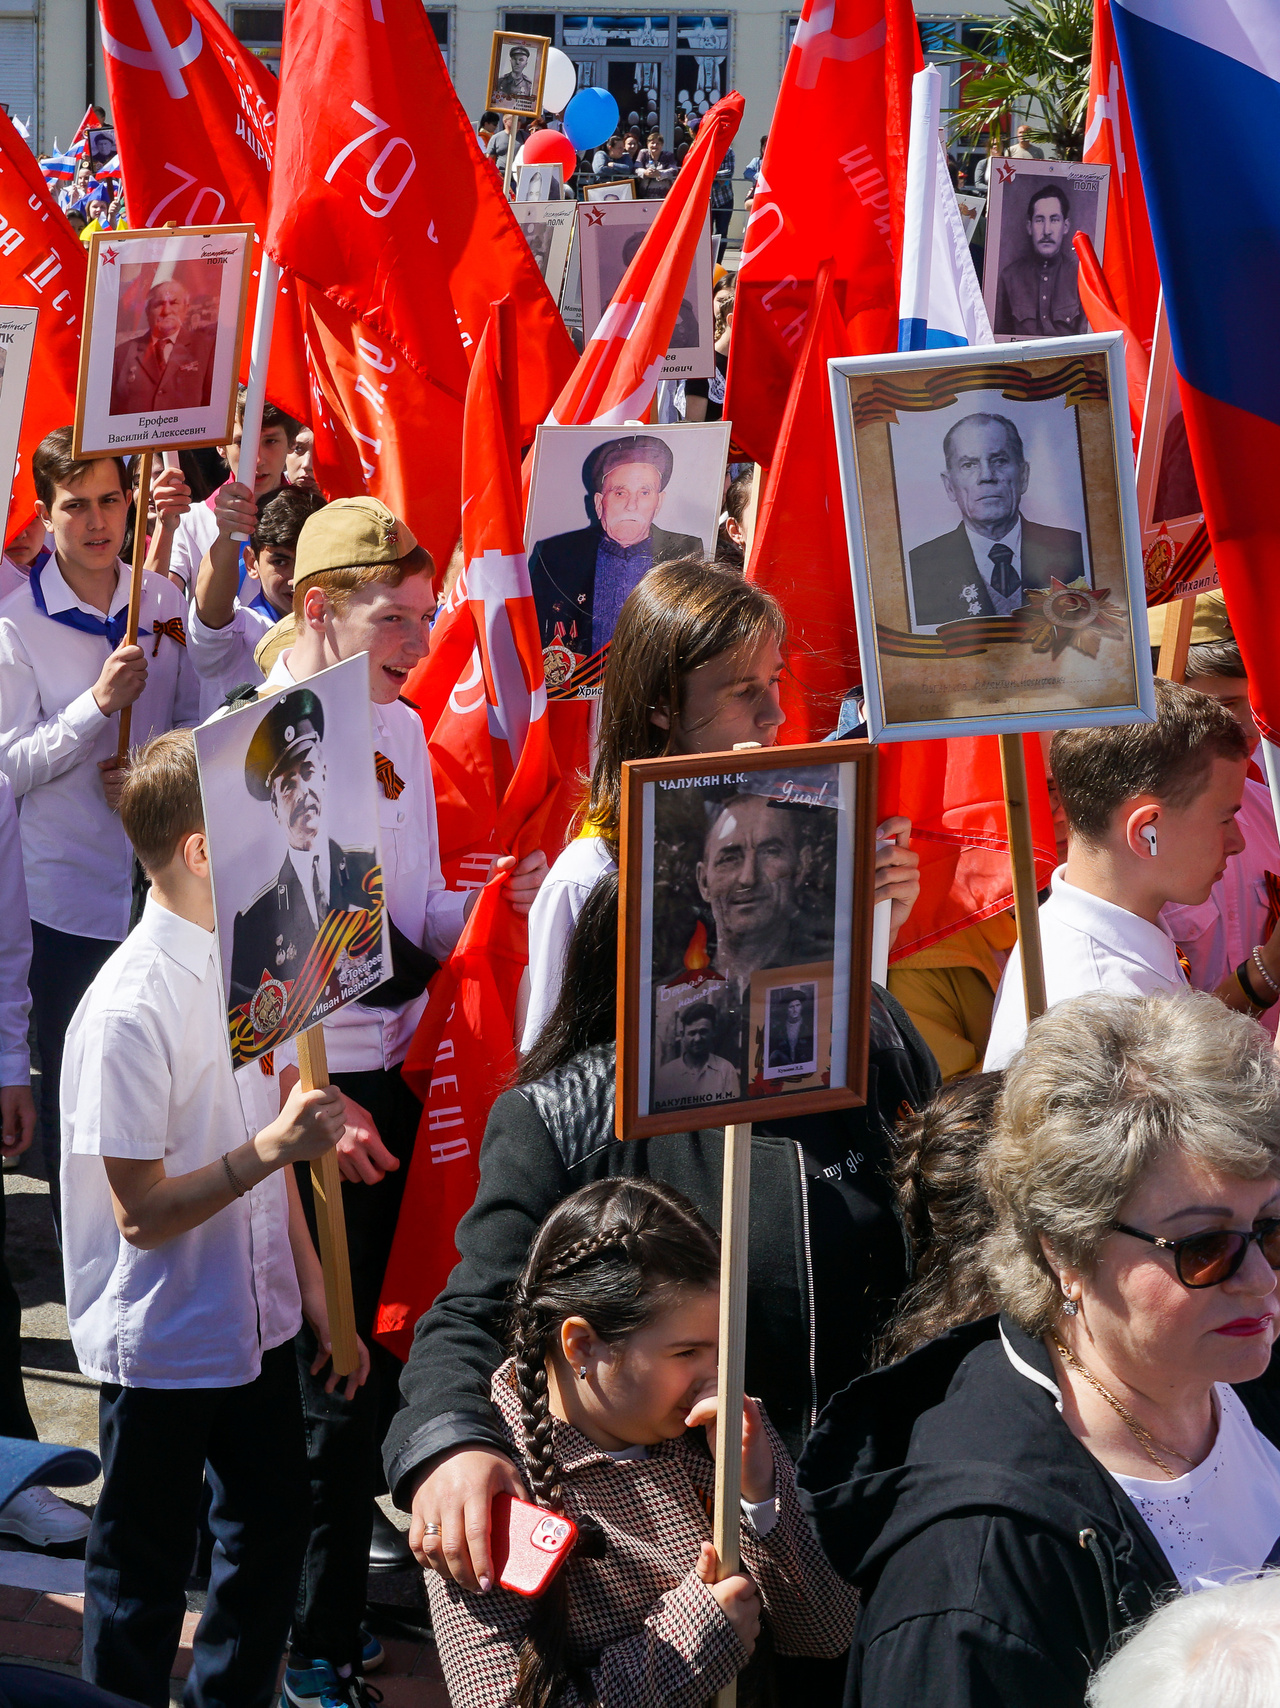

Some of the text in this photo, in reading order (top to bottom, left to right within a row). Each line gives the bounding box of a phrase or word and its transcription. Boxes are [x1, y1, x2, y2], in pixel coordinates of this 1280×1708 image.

[324, 100, 417, 218] 79
[1074, 181, 1097, 191] ПОЛК
[207, 257, 228, 265] ПОЛК
[138, 415, 179, 428] Ерофеев
[108, 427, 207, 444] Василий Алексеевич
[1174, 576, 1211, 595] Михаил
[578, 685, 603, 698] Хрис
[659, 773, 748, 791] ЧАЛУКЯН К.К.
[347, 953, 384, 981] Токарев
[316, 967, 385, 1017] Иван Иванович
[655, 1090, 736, 1109] ВАКУЛЕНКО И.М.
[823, 1163, 842, 1180] my
